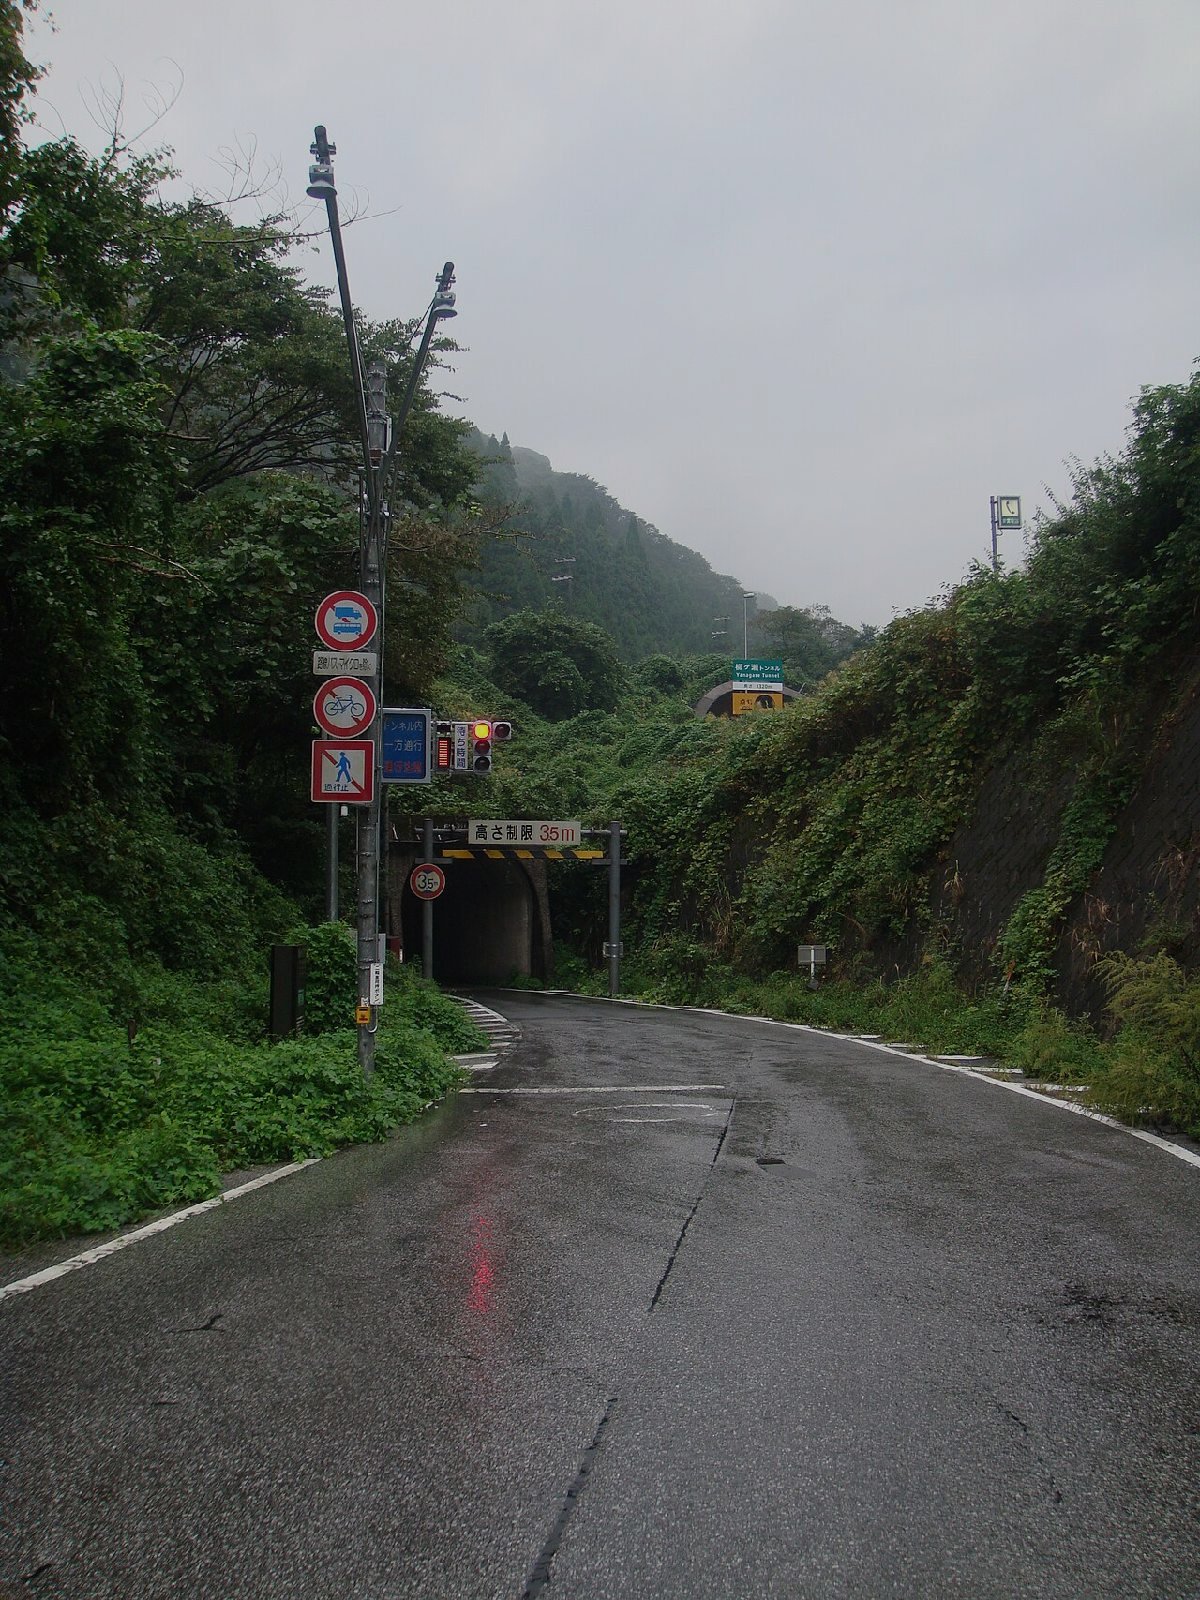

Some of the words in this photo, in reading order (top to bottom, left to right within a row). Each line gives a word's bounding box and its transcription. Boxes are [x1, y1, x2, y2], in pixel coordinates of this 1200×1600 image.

[384, 739, 423, 752] 一方通行
[457, 726, 466, 769] 待ち時間
[475, 824, 533, 841] 高さ制限
